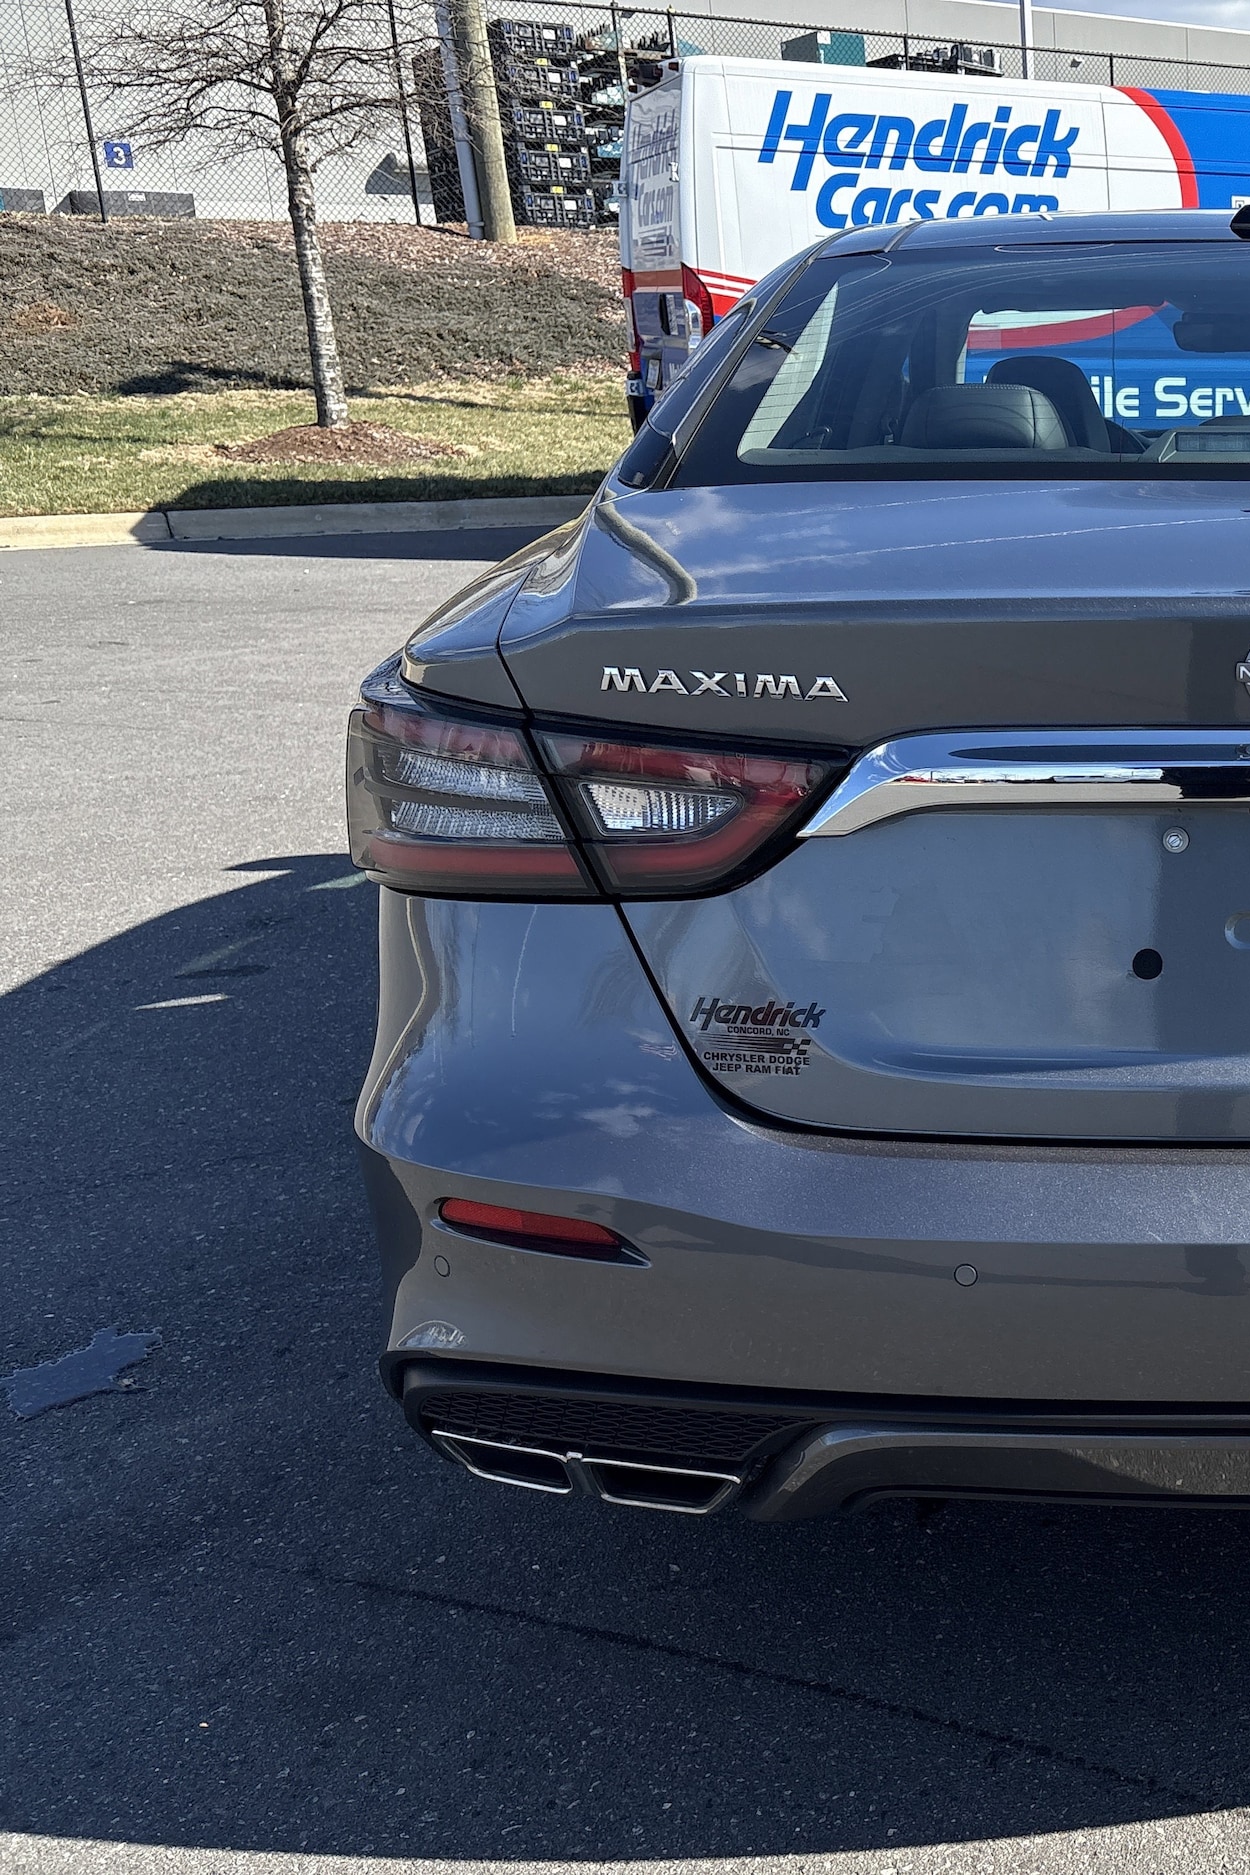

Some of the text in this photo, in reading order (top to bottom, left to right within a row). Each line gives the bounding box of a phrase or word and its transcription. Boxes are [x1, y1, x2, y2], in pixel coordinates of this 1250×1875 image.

[758, 89, 1080, 191] Hendrick
[112, 146, 127, 166] 3
[815, 172, 1060, 230] Carsco
[600, 665, 850, 703] MAXIMA
[689, 996, 827, 1032] Hendrick
[727, 1025, 790, 1037] CONCORD, NC
[703, 1051, 811, 1066] CHRYSLER DODGE
[712, 1062, 802, 1076] JEEP RAM FIAT
